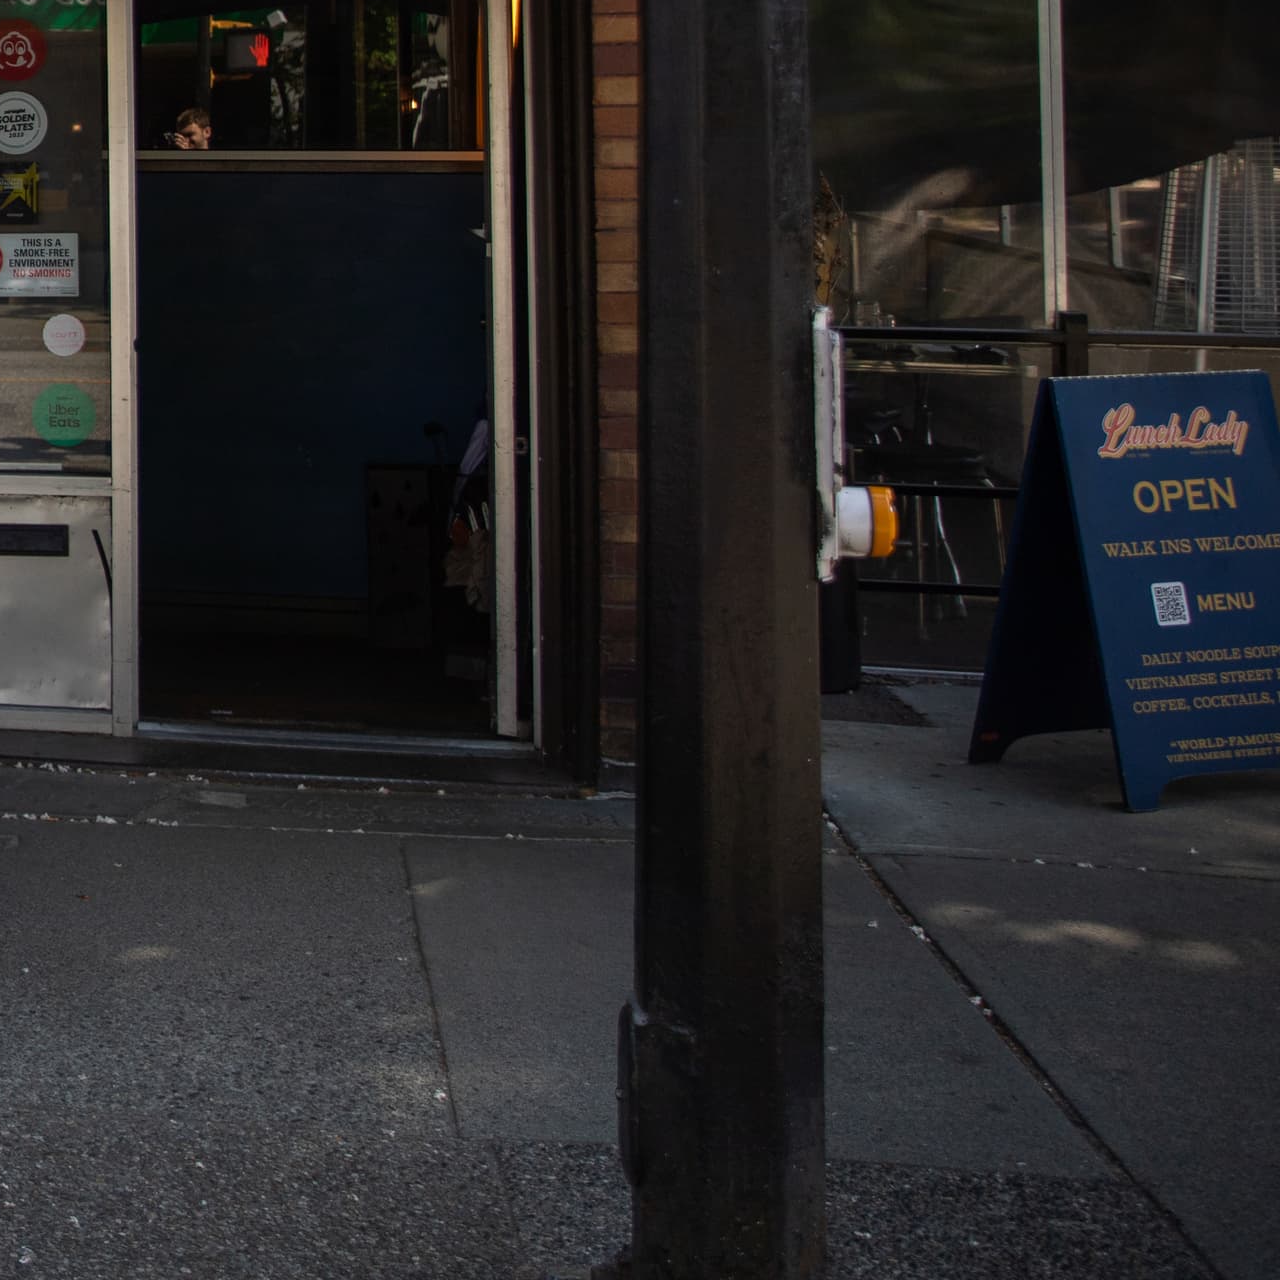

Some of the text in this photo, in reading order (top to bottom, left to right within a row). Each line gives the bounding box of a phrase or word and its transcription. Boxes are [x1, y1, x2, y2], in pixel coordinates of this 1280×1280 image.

[21, 238, 62, 247] THIS IS A
[13, 248, 70, 257] SMOKE-FREE
[9, 258, 75, 268] ENVIRONMENT
[12, 268, 71, 278] NO SMOKING
[48, 403, 81, 416] Uber
[48, 416, 81, 428] Eats
[1096, 402, 1249, 459] Lunch Lady
[1132, 475, 1238, 515] OPEN
[1102, 532, 1280, 559] WALK INS WELCOME
[1196, 590, 1257, 613] MENU
[1140, 651, 1183, 667] DAILY
[1185, 647, 1241, 663] NOODLE
[1124, 672, 1218, 691] VIETNAMESE
[1219, 668, 1273, 685] STREET
[1132, 697, 1192, 715] COFFEE,
[1192, 691, 1275, 710] COCKTAILS,
[1166, 749, 1234, 764] VIETNAMESE
[1233, 746, 1273, 759] STREET
